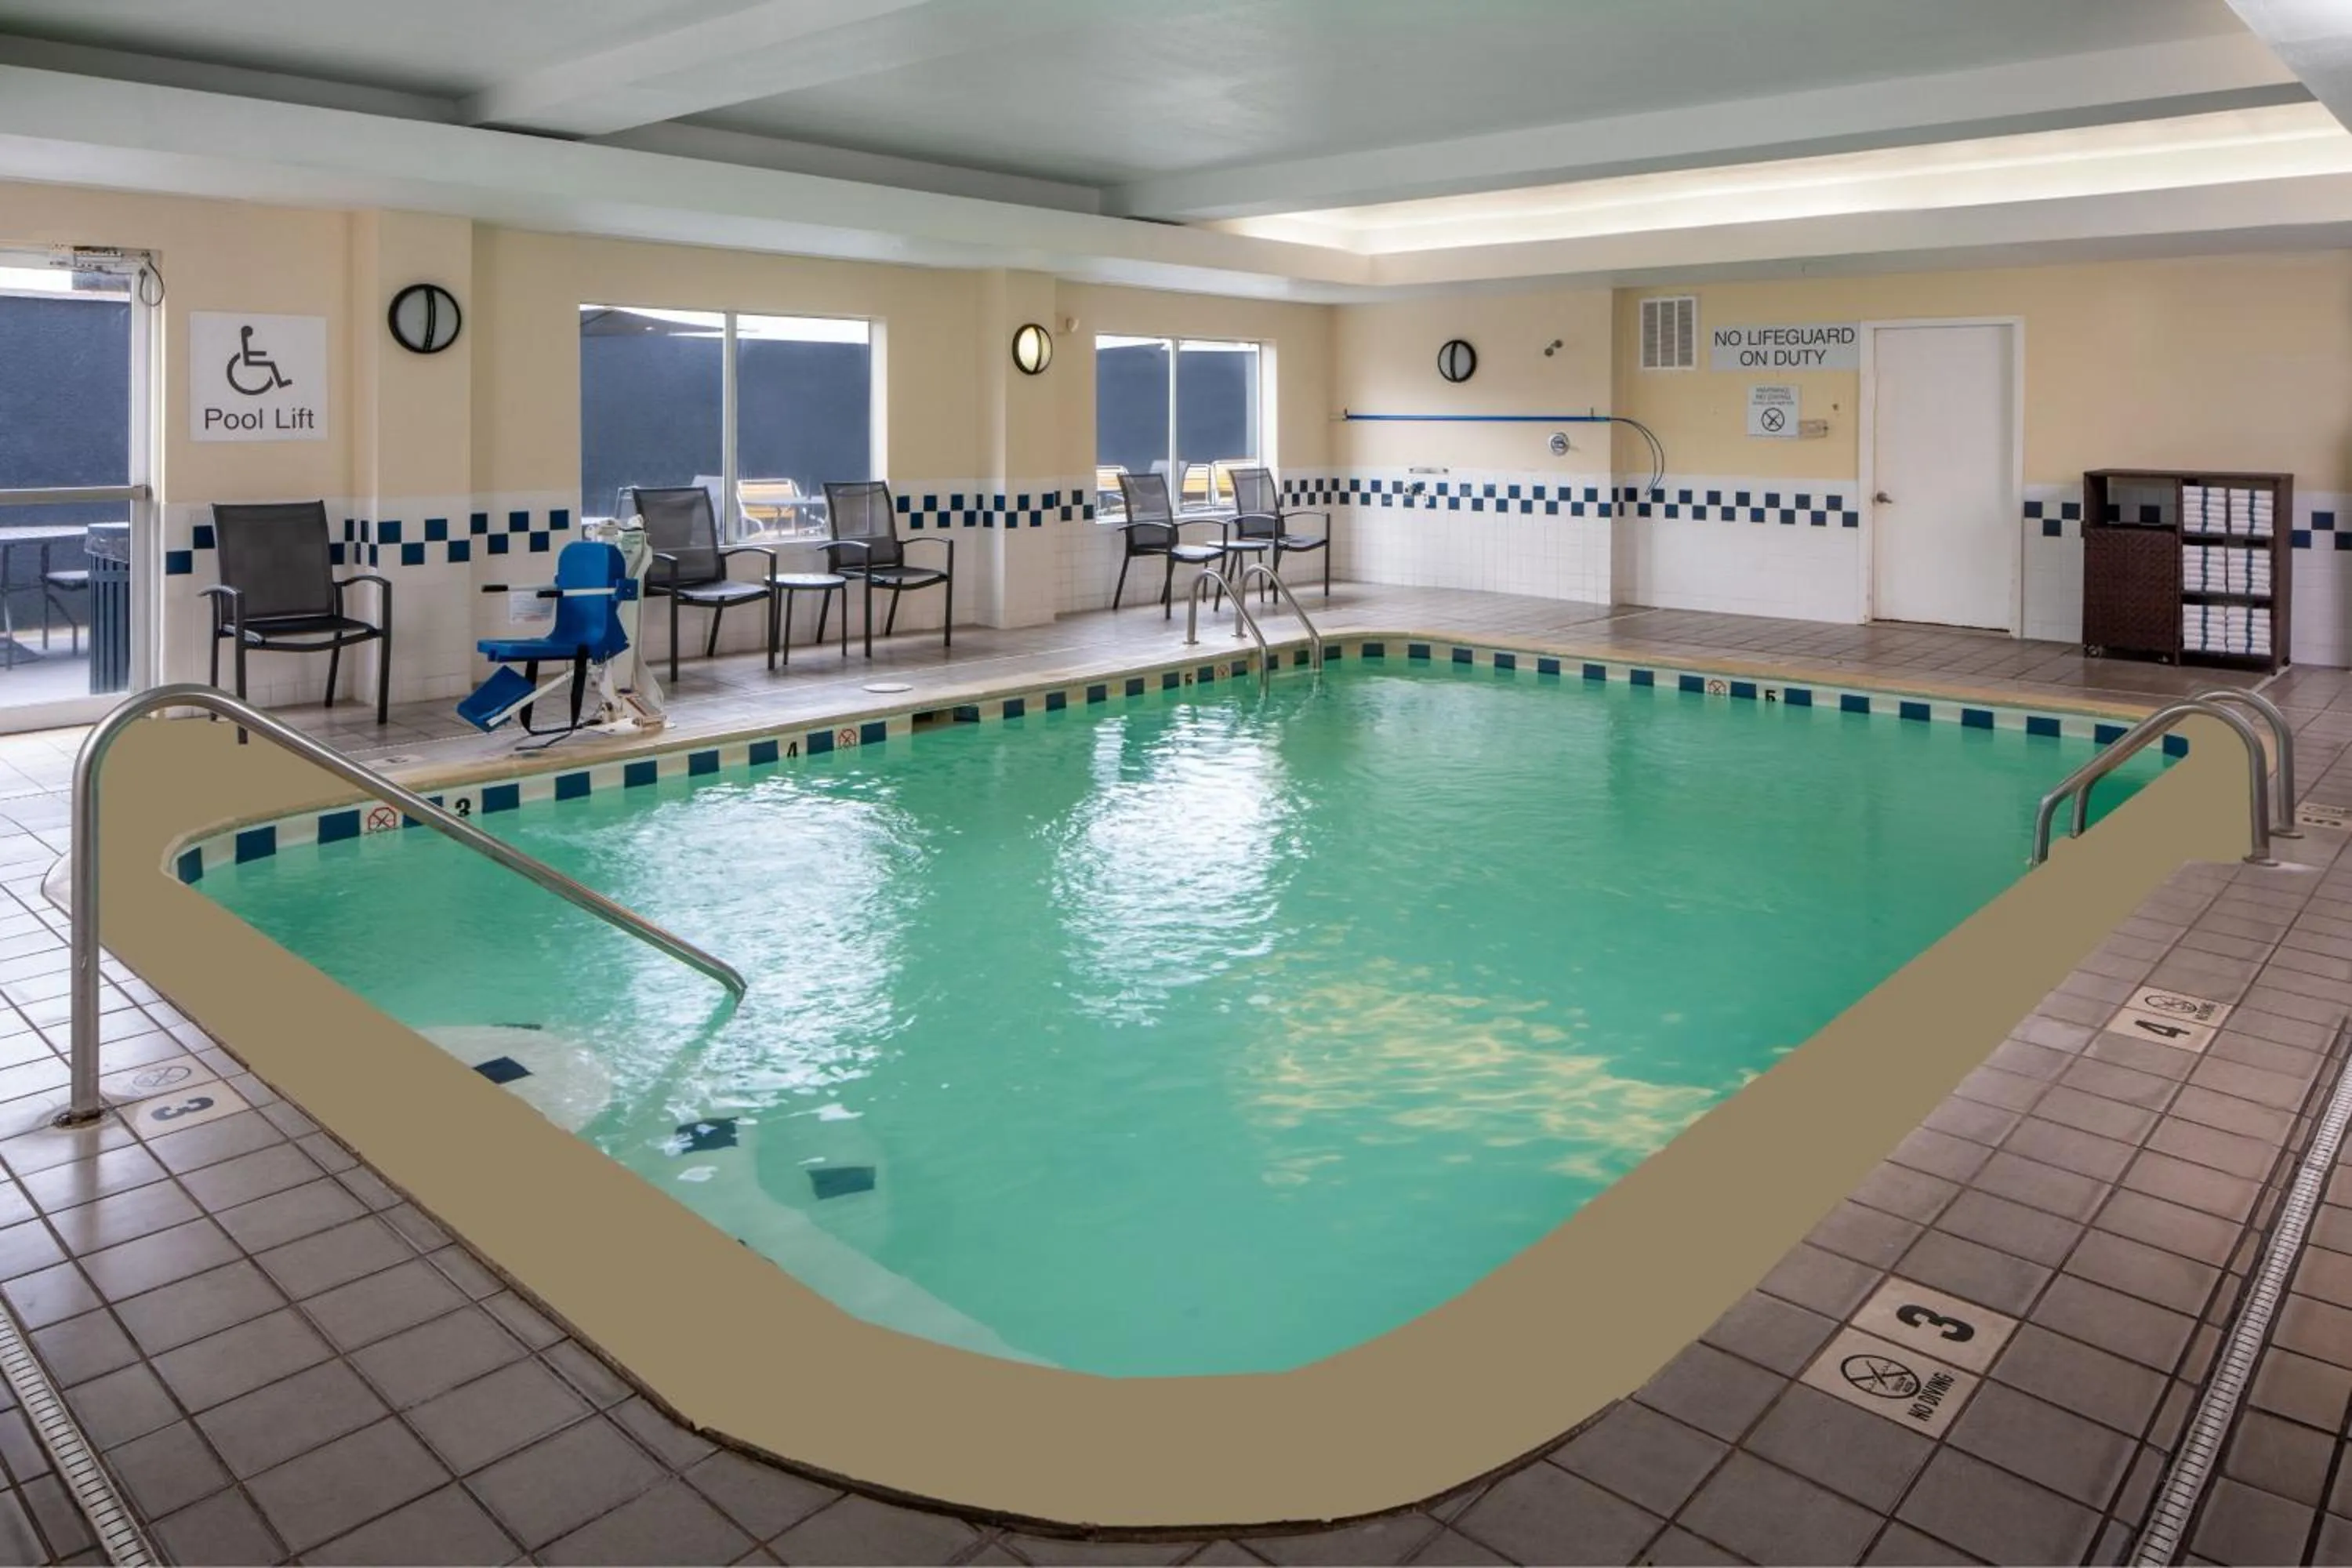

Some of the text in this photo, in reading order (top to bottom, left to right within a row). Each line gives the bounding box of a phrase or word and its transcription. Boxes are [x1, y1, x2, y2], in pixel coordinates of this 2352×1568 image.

[1715, 328, 1855, 347] NO LIFEGUARD
[1740, 350, 1827, 366] ON DUTY
[205, 408, 314, 430] Pool Lift
[455, 797, 471, 817] 3
[2135, 1020, 2191, 1038] 4
[151, 1097, 214, 1121] 3
[1896, 1305, 1974, 1342] 3
[1907, 1373, 1955, 1421] NO DIVING
